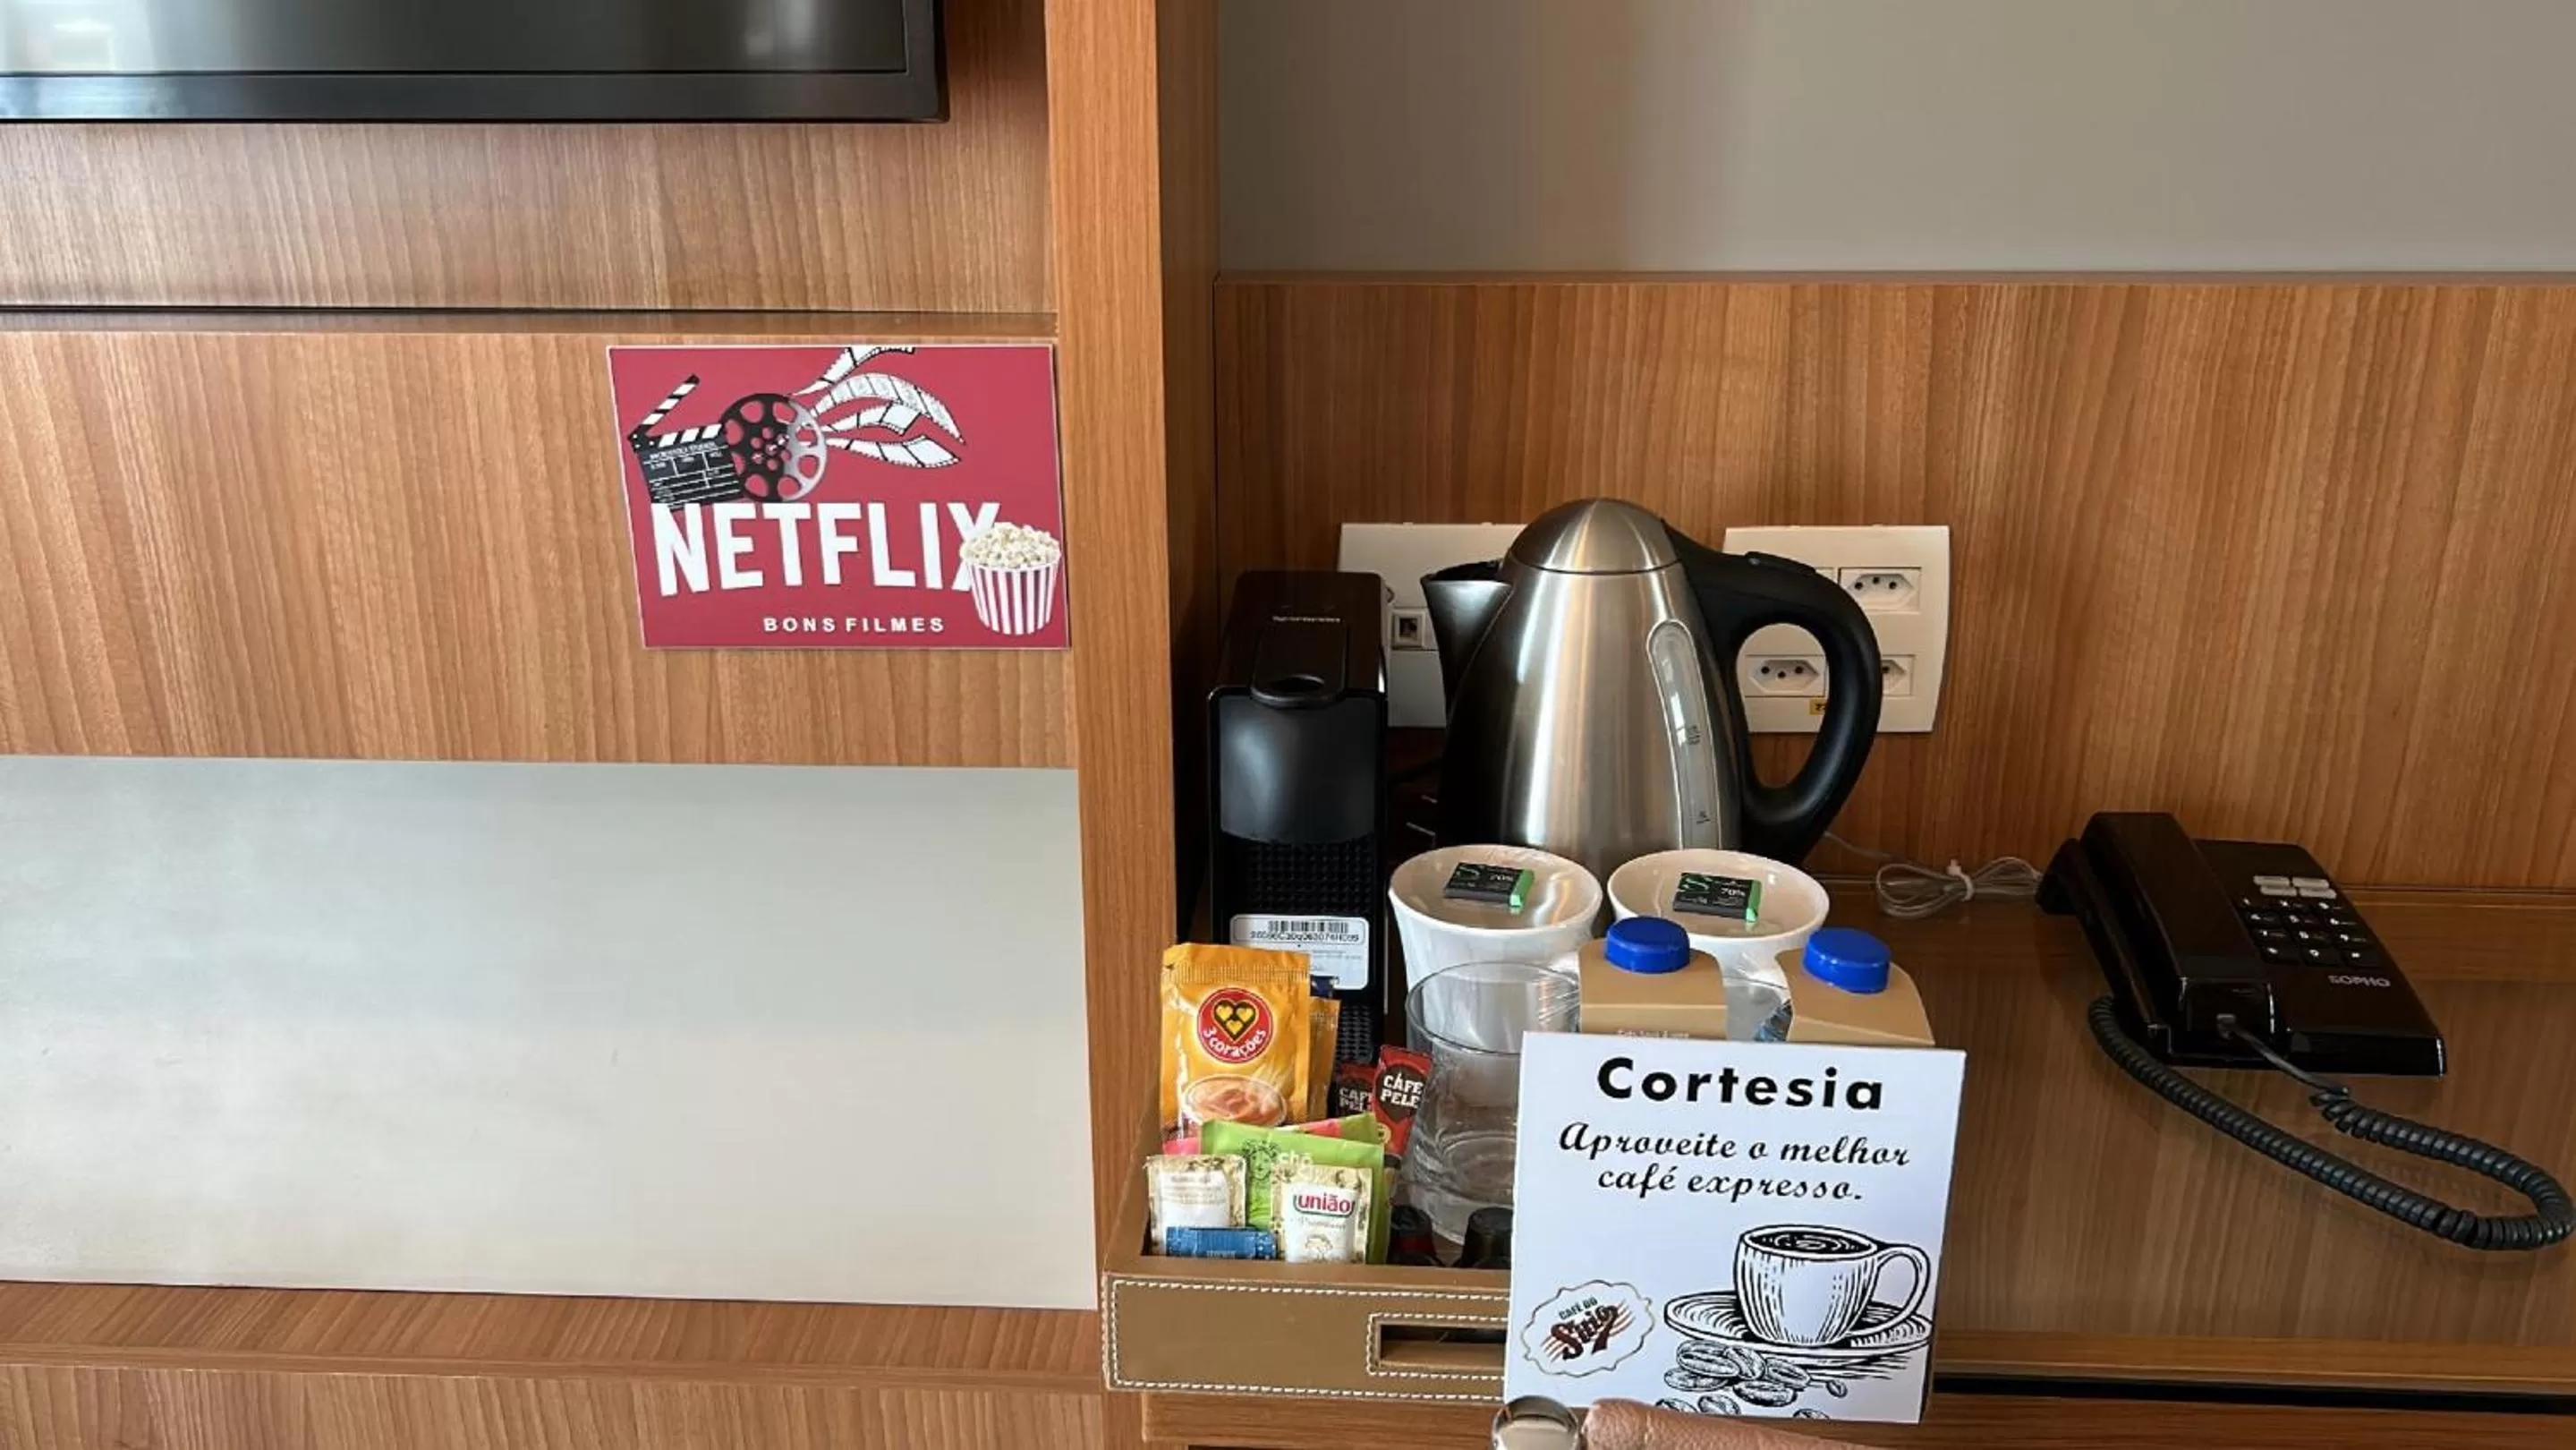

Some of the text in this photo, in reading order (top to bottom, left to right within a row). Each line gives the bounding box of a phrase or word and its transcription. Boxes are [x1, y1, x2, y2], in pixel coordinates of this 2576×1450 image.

[651, 503, 1000, 596] NETFLIX
[763, 617, 945, 632] BONS FILMES
[1203, 1026, 1218, 1038] 3
[1597, 1056, 1883, 1110] Cortesia
[1559, 1122, 1910, 1165] Aproveite o melhor
[1297, 1192, 1351, 1214] união
[1598, 1163, 1863, 1204] café expresso.
